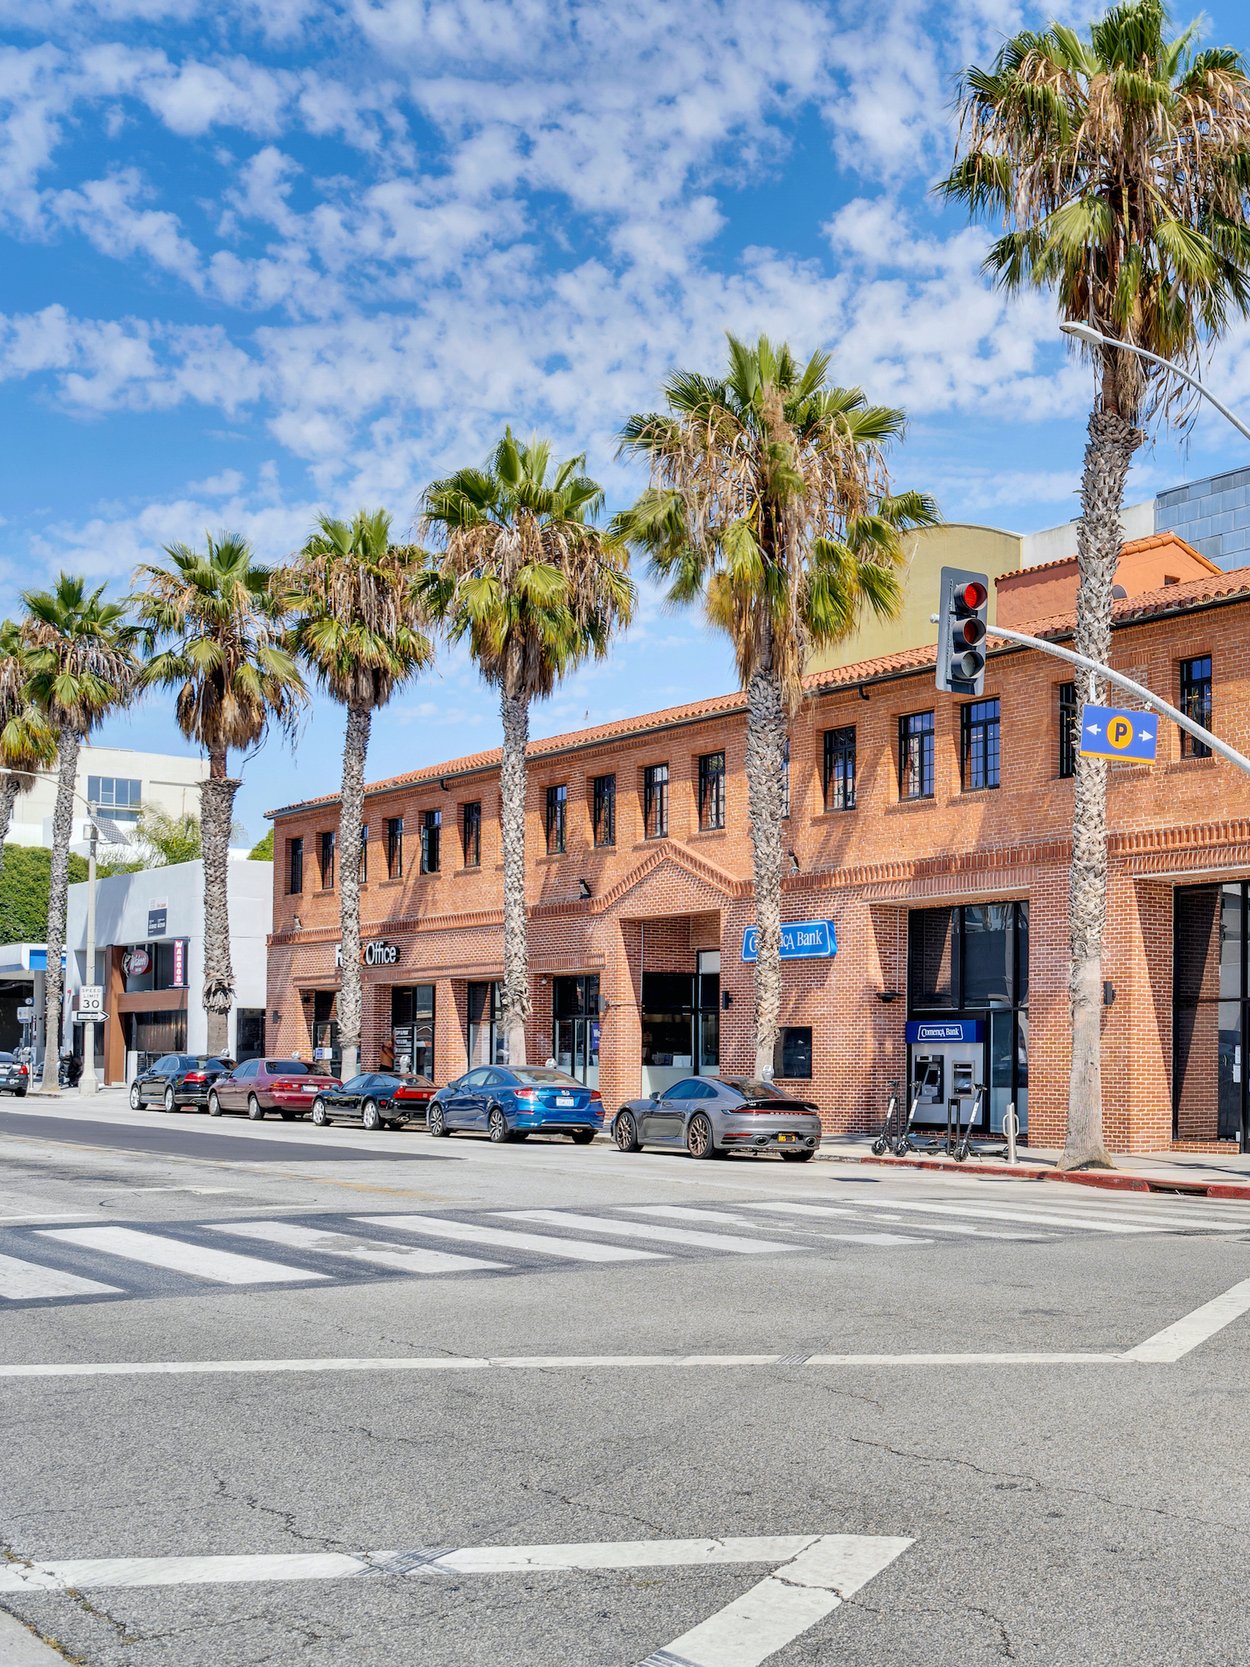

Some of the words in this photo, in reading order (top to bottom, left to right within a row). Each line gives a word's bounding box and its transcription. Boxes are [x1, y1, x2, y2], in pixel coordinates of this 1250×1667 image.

[1114, 722, 1128, 742] P
[796, 929, 823, 947] Bank
[365, 941, 397, 965] Office
[82, 999, 100, 1009] 30
[945, 1027, 960, 1036] Bank
